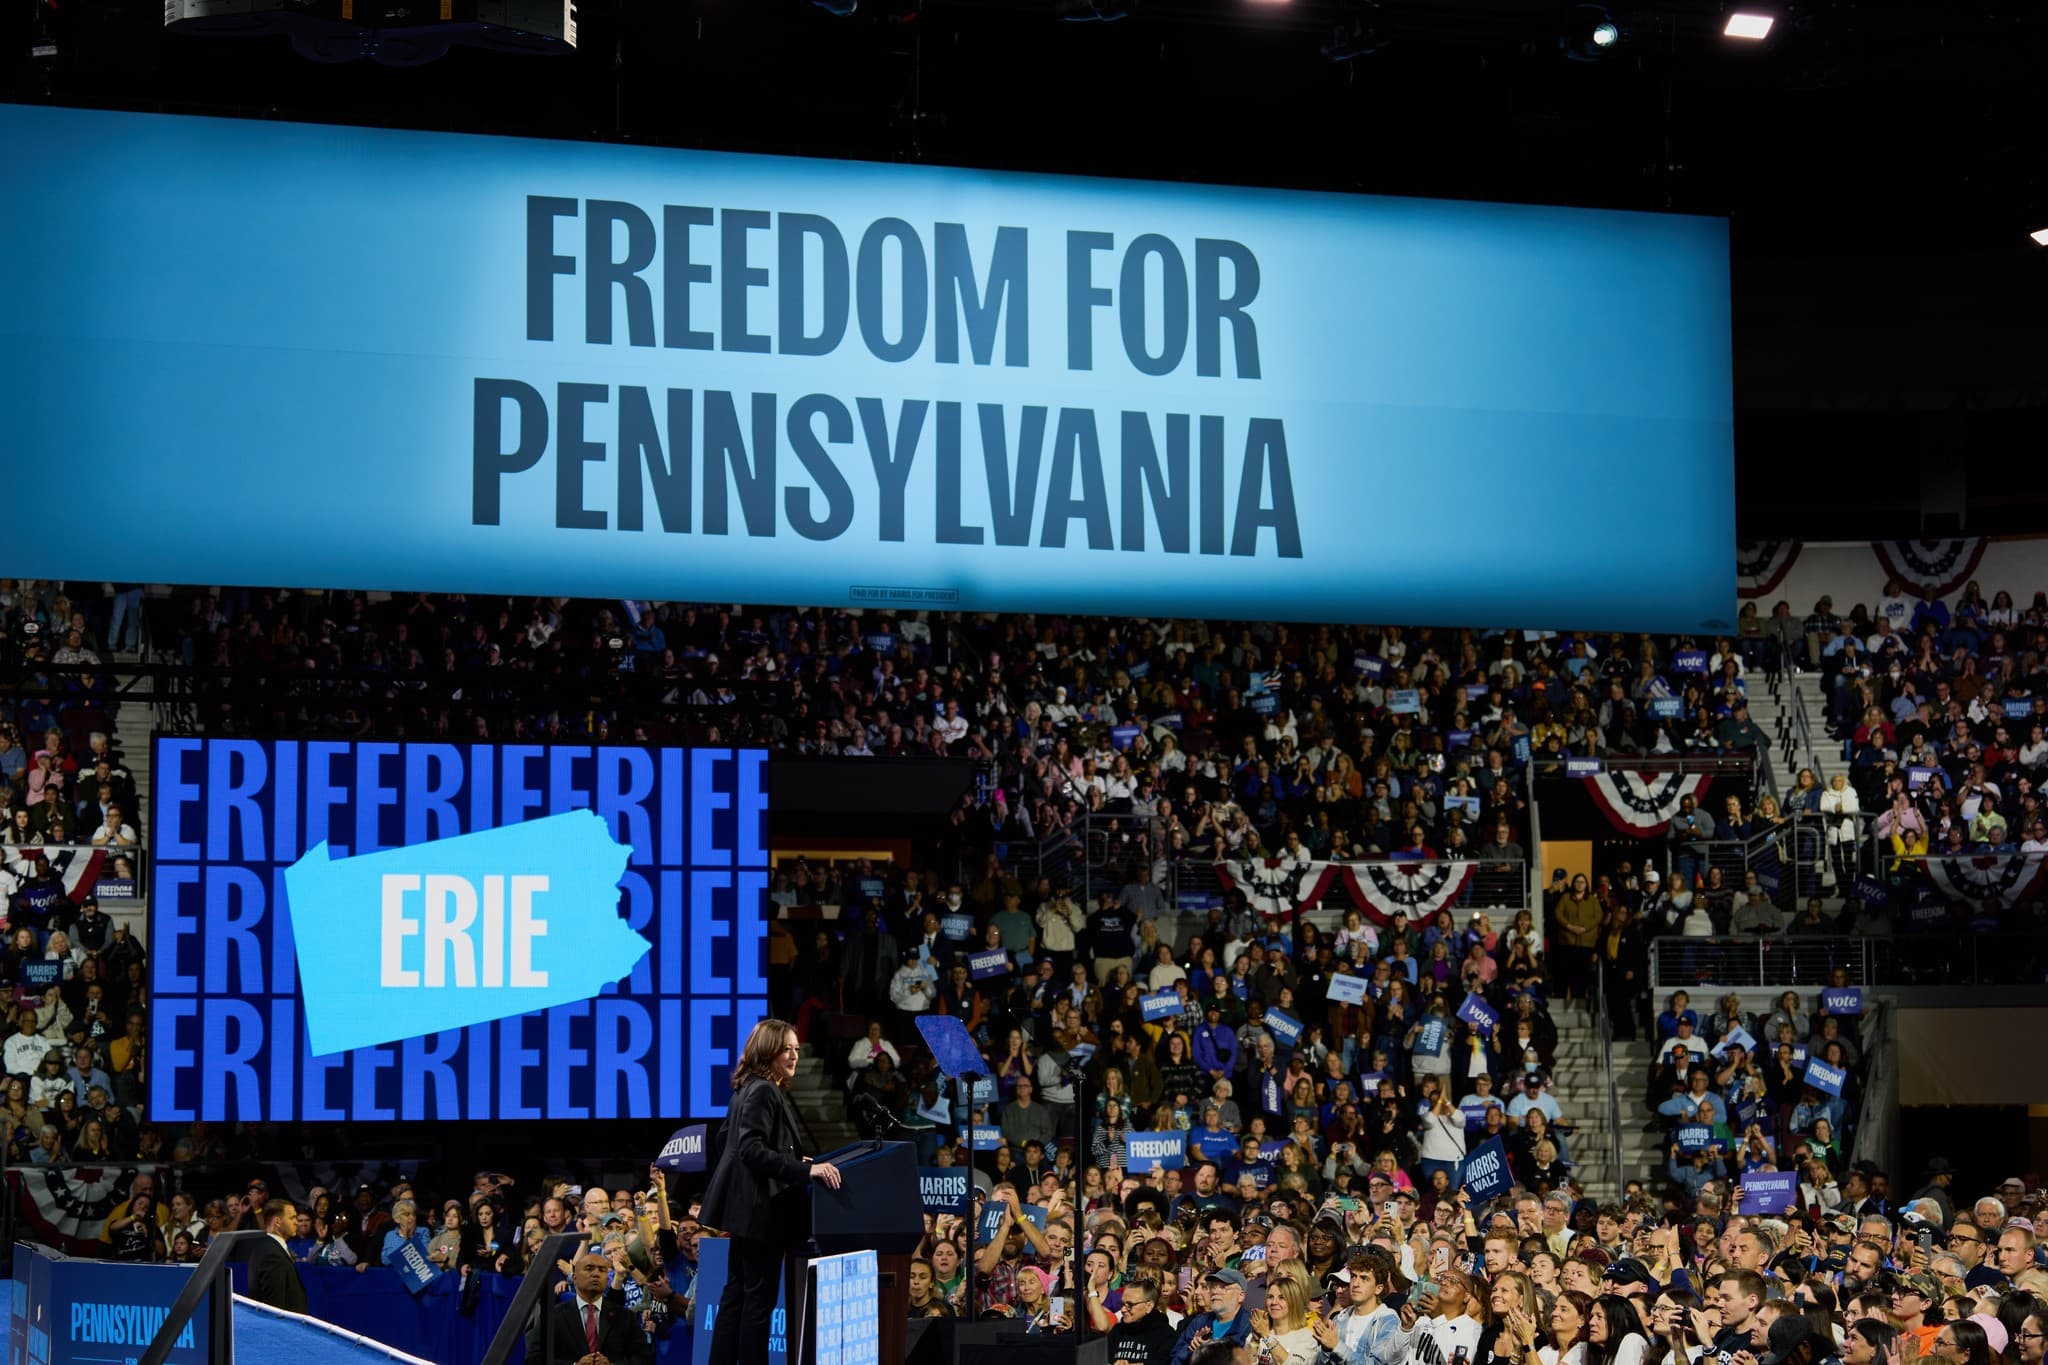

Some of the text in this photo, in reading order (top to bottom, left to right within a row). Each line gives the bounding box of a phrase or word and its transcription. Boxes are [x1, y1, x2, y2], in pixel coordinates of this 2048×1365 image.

[525, 194, 1261, 380] FREEDOM FOR
[472, 377, 1304, 559] PENNSYLVANIA
[1678, 656, 1703, 668] vote
[1567, 761, 1599, 771] FREEDOM
[97, 884, 133, 896] FREEDOM
[1911, 906, 1945, 921] FREEDOM
[380, 874, 549, 988] ERIE
[971, 953, 1005, 970] FREEDOM
[27, 965, 58, 976] HARRIS
[1143, 996, 1180, 1012] FREEDOM
[1827, 995, 1857, 1008] vote
[1468, 1005, 1493, 1028] vote
[1265, 1013, 1299, 1038] FREEDOM
[1426, 1020, 1442, 1052] HARRIS
[1809, 1063, 1842, 1087] FREEDOM
[962, 1079, 992, 1093] HRRIS
[962, 1130, 999, 1140] FEEDOM
[1678, 1128, 1709, 1140] HARRIS
[1130, 1138, 1181, 1157] FREEDOM
[1466, 1150, 1500, 1184] HARRIS
[1472, 1171, 1500, 1193] WALZ
[1744, 1179, 1789, 1192] PENNSYLVANIA
[922, 1195, 959, 1206] WALZ
[400, 1243, 434, 1283] FREEDOM
[71, 1302, 194, 1349] PENNSYLVAA
[1119, 1341, 1146, 1351] MADE BY
